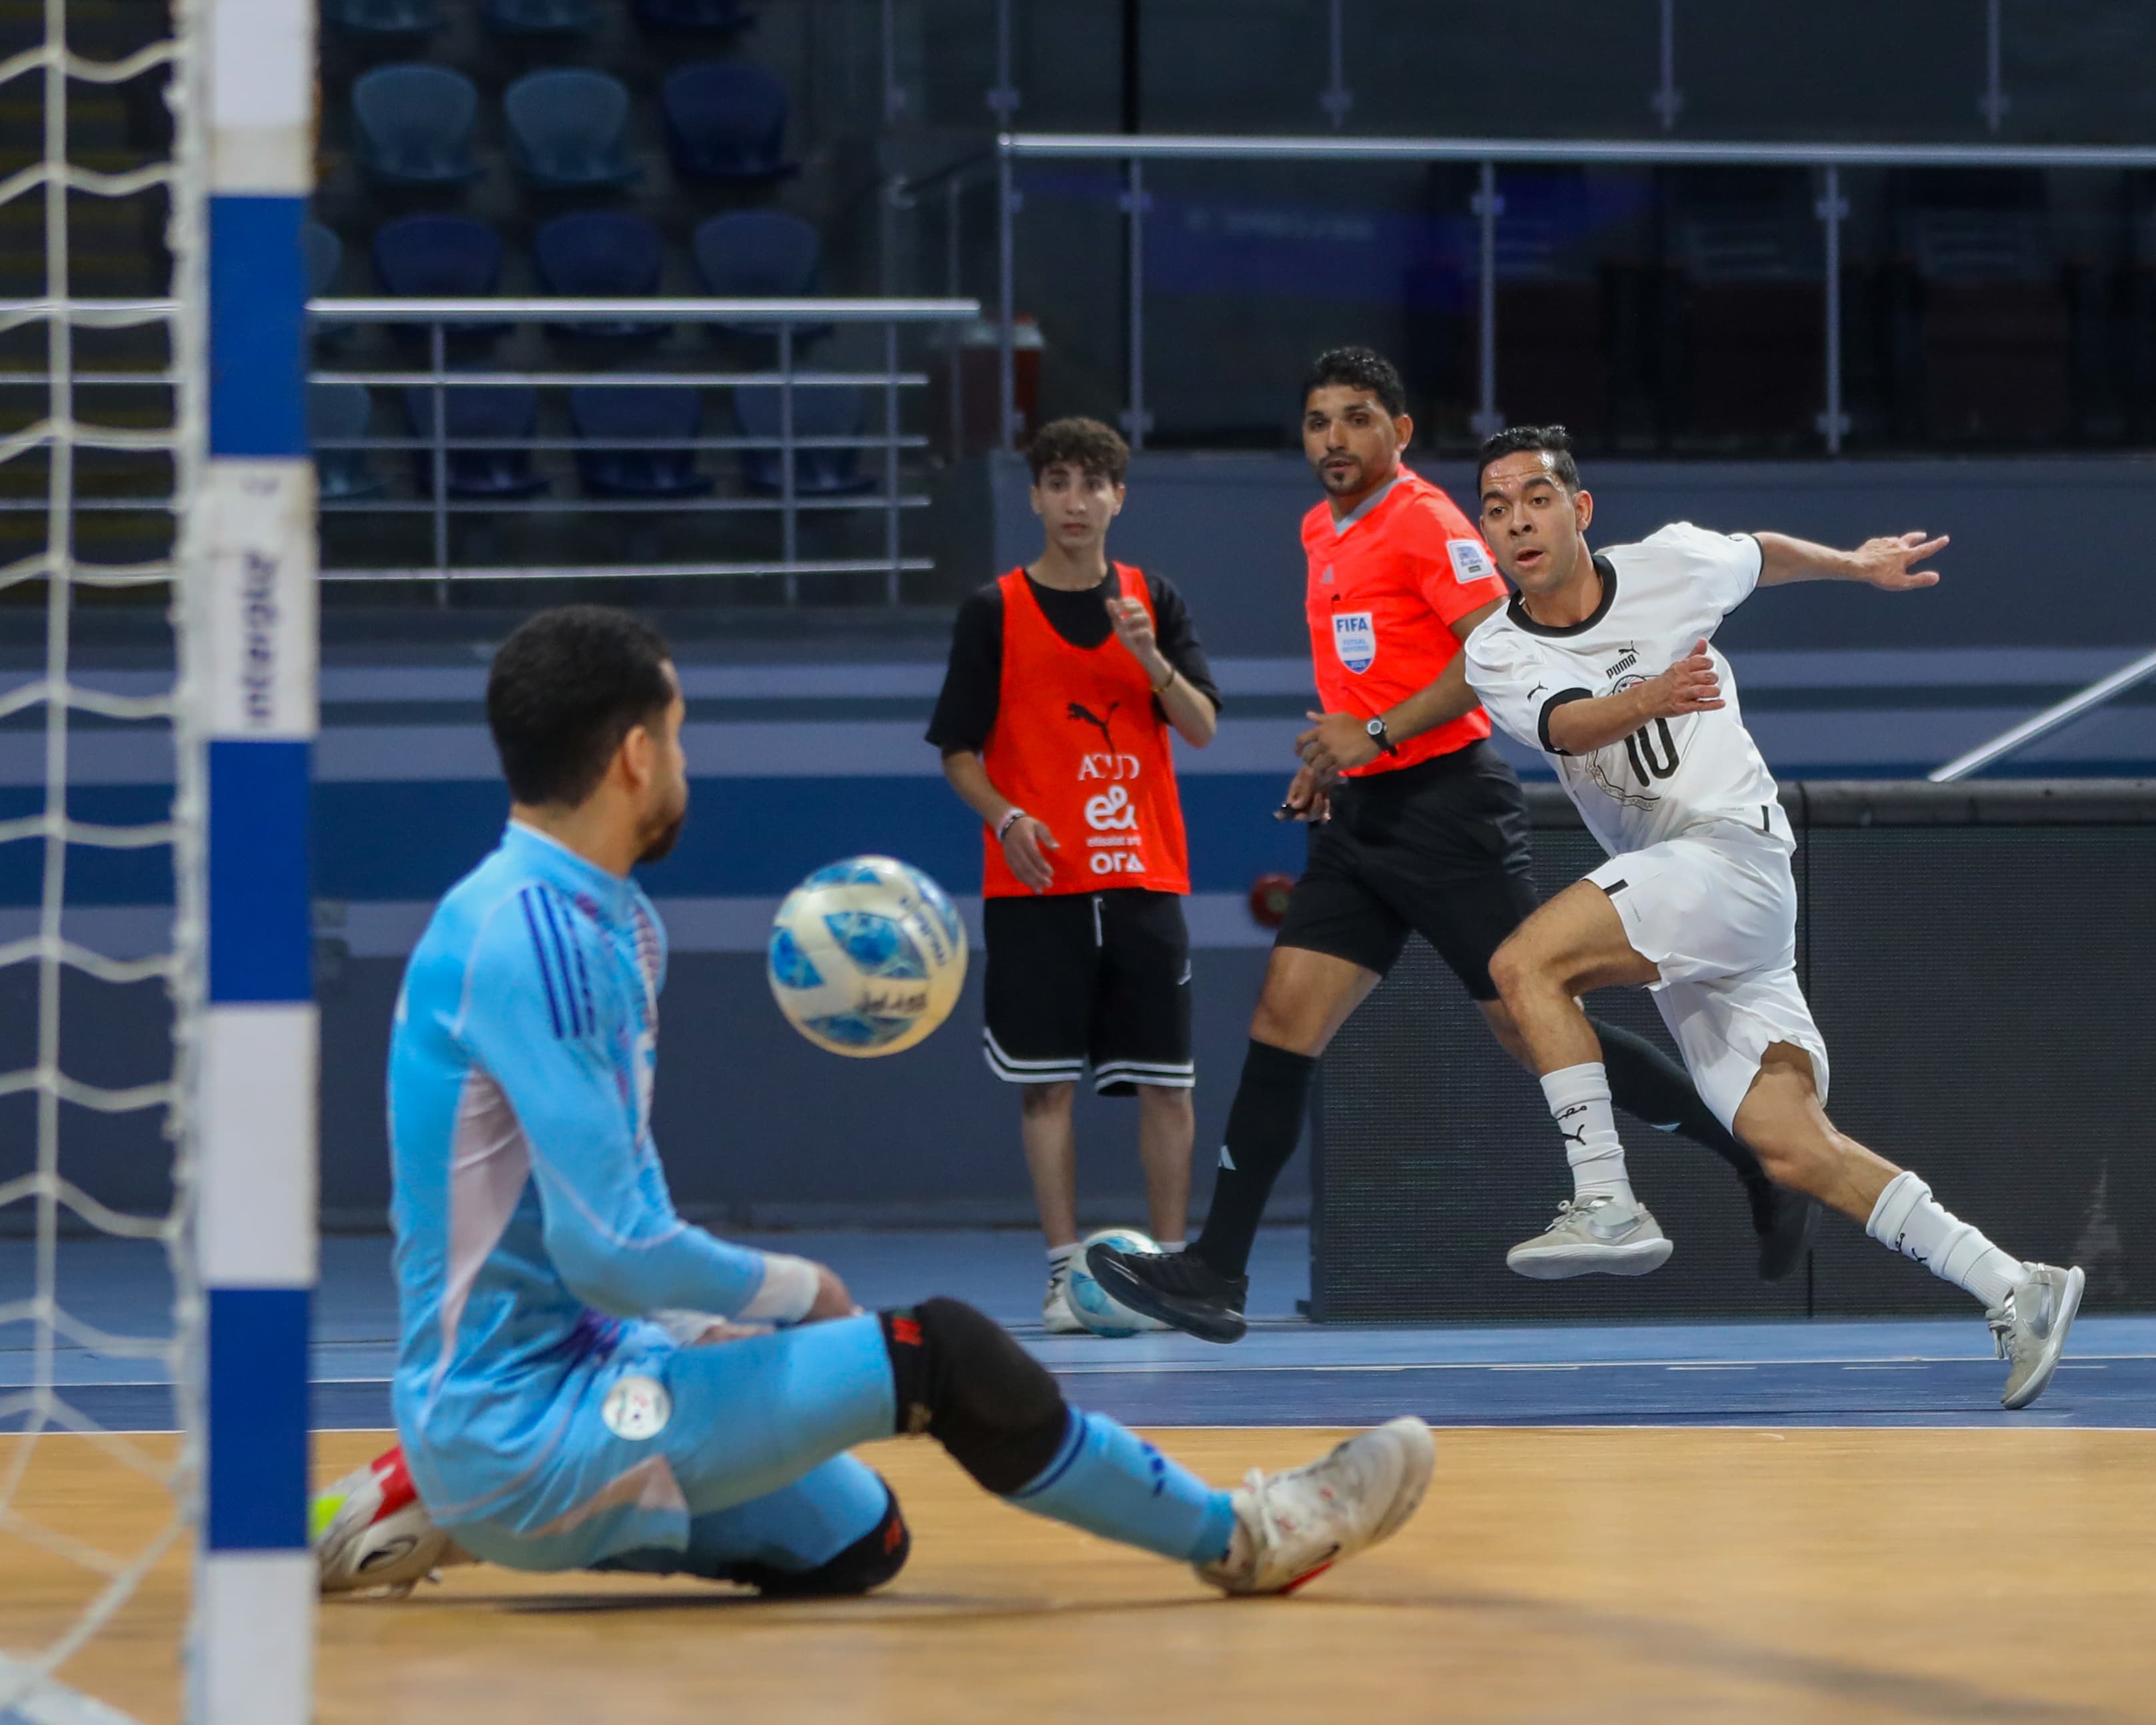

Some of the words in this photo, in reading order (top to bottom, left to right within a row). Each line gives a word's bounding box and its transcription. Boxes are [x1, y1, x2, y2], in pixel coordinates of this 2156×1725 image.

[1336, 617, 1368, 632] FIFA
[1605, 654, 1637, 680] PUMA
[1625, 718, 1680, 787] 10
